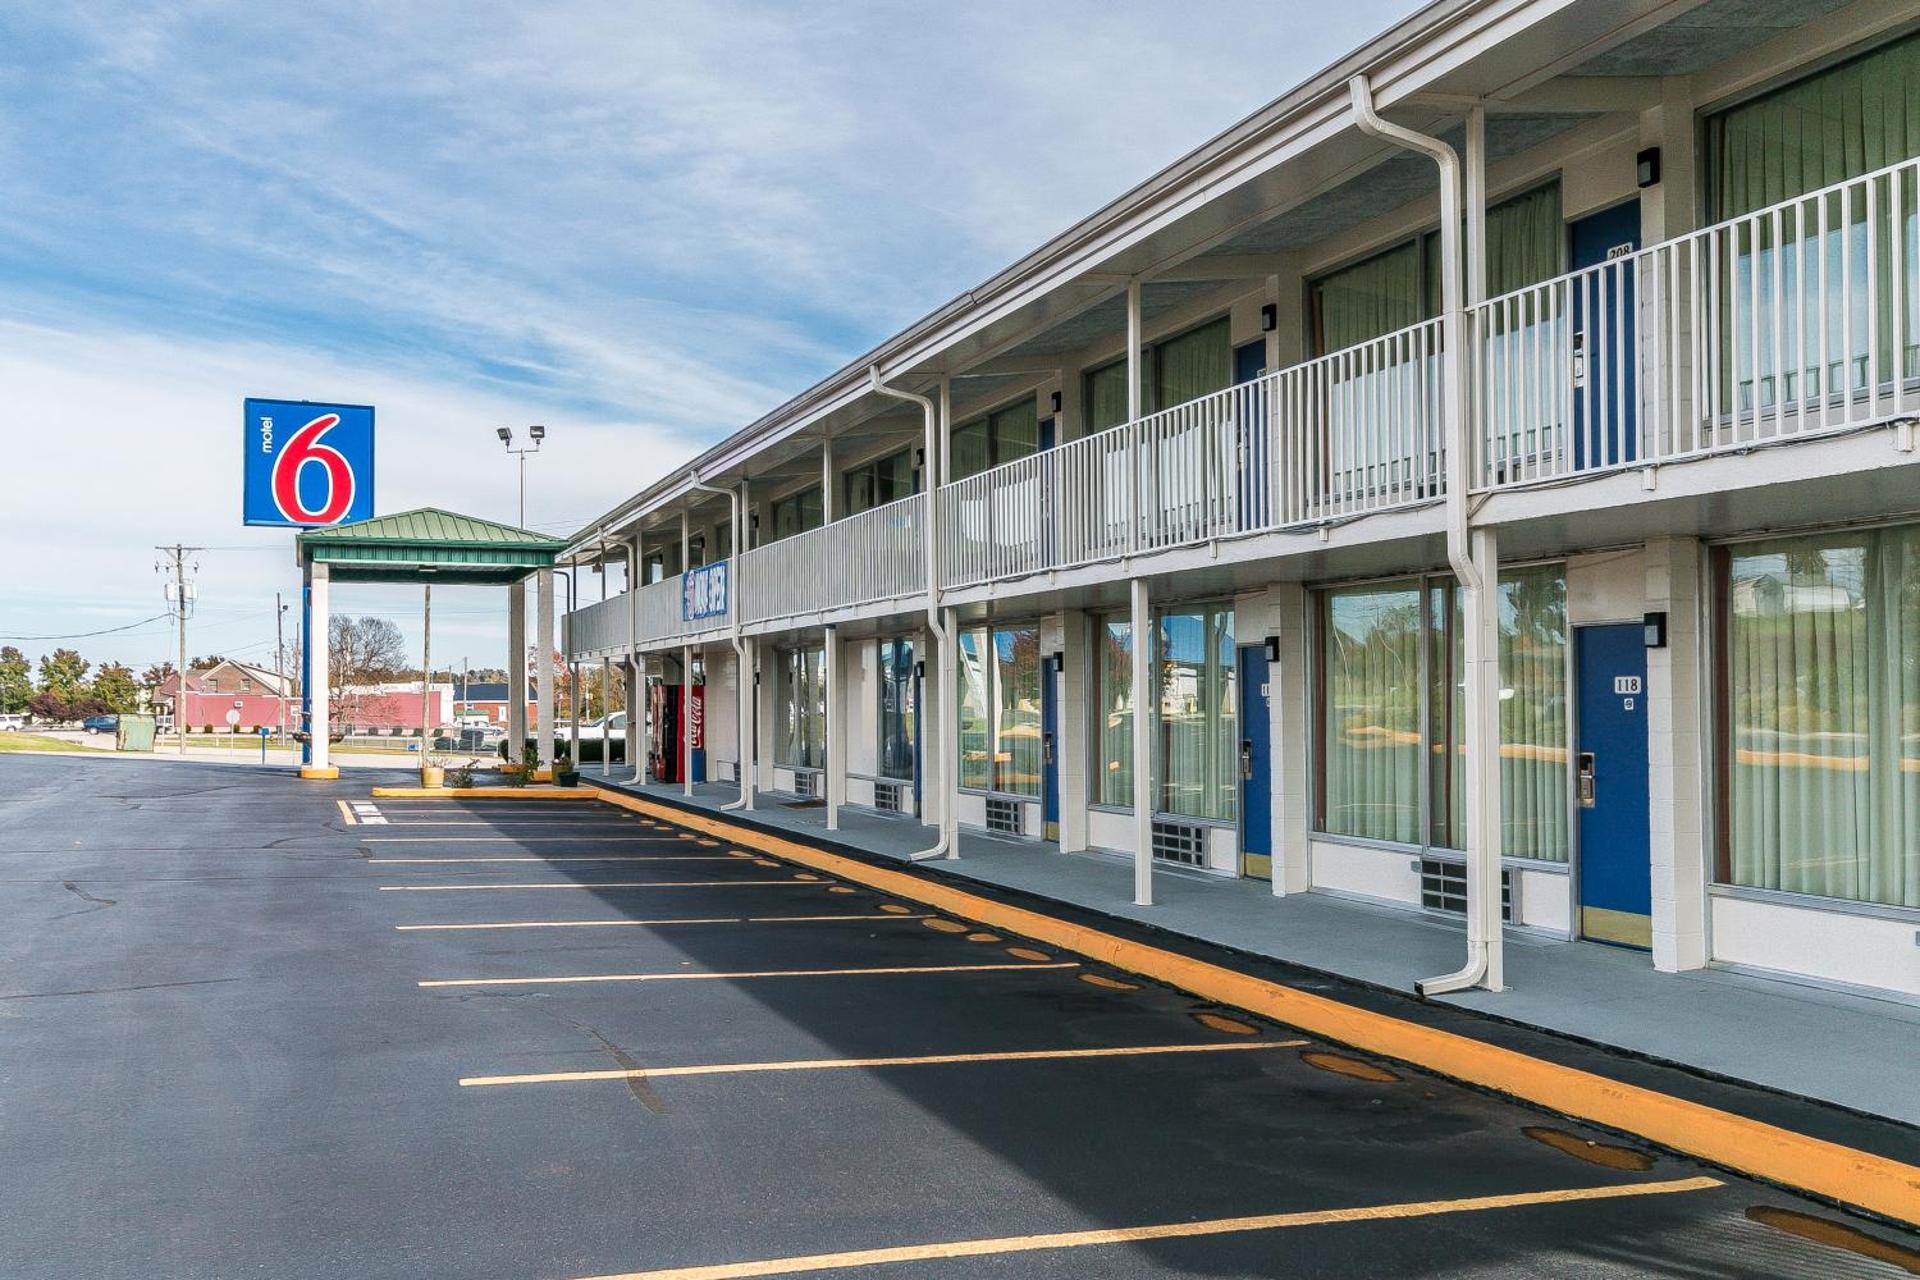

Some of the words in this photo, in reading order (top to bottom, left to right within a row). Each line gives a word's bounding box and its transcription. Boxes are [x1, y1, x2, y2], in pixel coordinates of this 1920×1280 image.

[260, 416, 273, 453] motel
[271, 413, 356, 525] 6
[1617, 678, 1638, 692] 118
